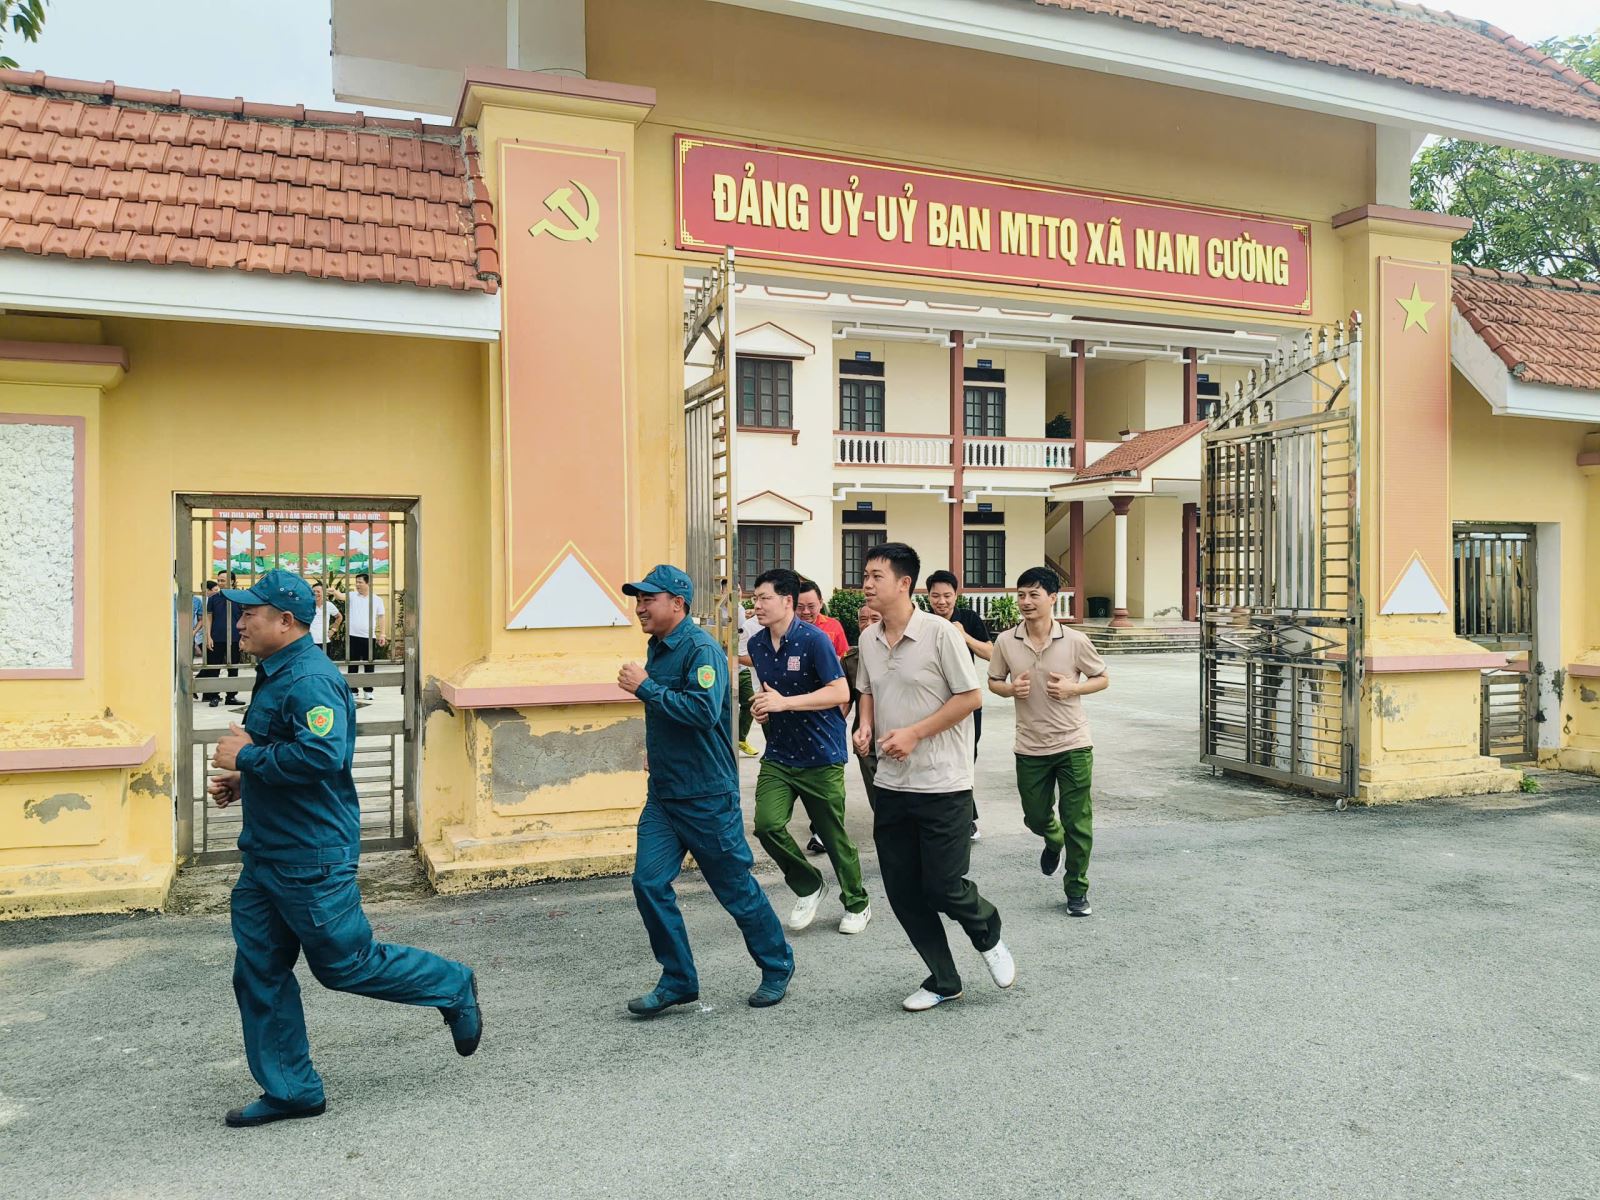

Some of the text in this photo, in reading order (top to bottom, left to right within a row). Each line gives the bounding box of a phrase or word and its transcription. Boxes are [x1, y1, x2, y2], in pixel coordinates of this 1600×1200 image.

[713, 162, 1289, 286] ĐẢNG UỶ-UỶ BAN MTTQ XÃ NAM CƯỜNG
